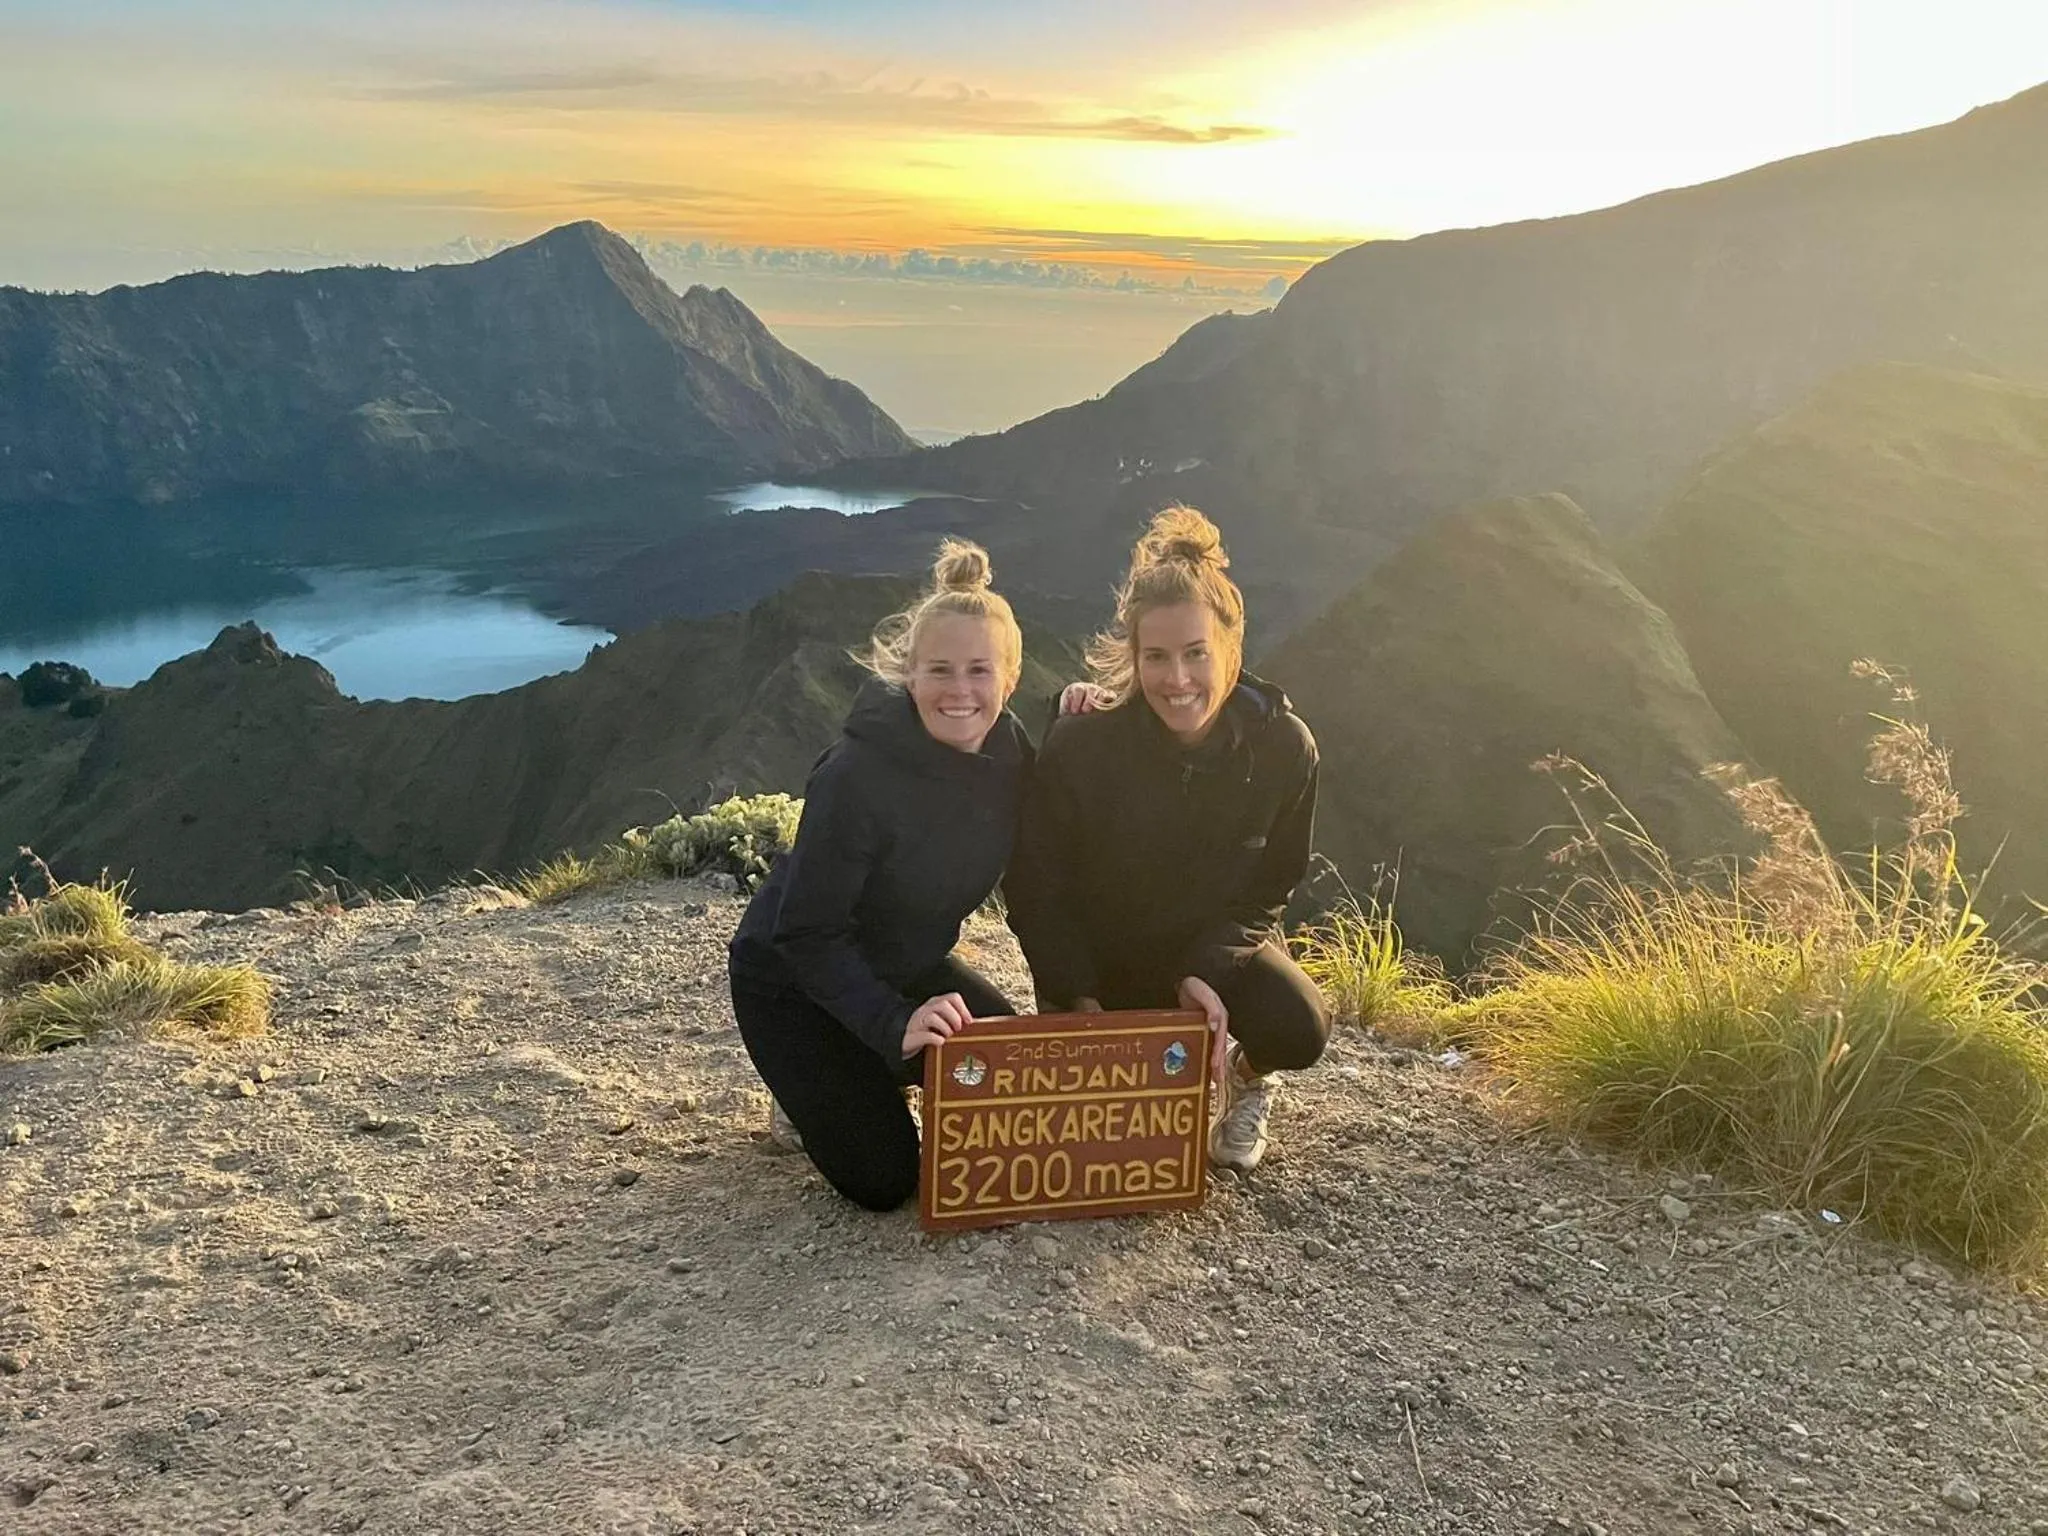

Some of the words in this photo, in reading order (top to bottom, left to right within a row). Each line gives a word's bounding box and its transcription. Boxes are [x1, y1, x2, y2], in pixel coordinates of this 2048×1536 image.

[994, 1062, 1149, 1094] RINJANI
[941, 1099, 1193, 1152] SANGKAREANG
[939, 1150, 1072, 1206] 3200
[1085, 1142, 1190, 1194] masl
